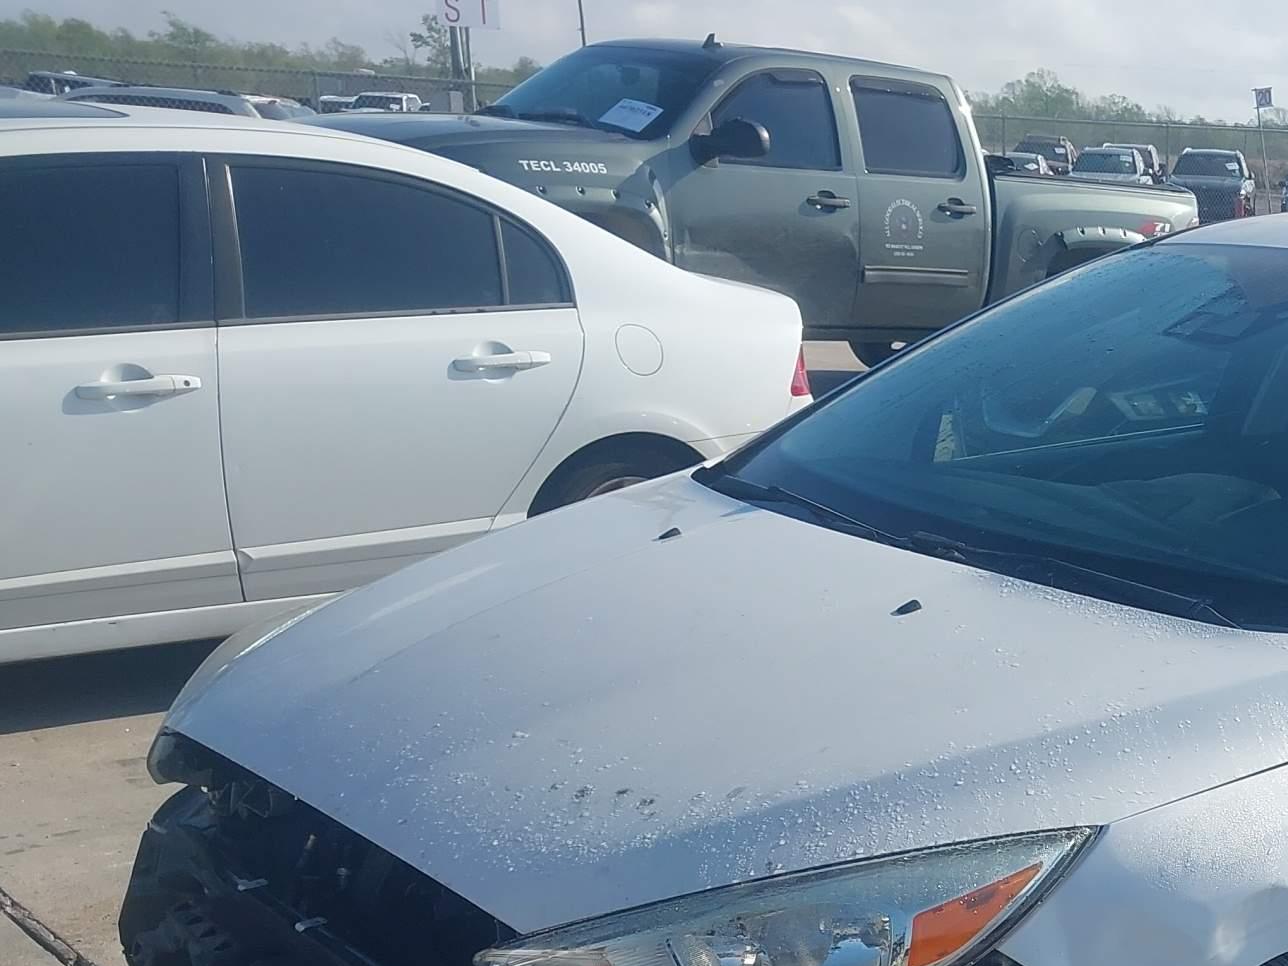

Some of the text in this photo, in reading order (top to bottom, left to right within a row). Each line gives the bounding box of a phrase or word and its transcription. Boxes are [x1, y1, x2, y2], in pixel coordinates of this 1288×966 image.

[1257, 91, 1272, 106] 20
[518, 159, 608, 175] TECL 34005
